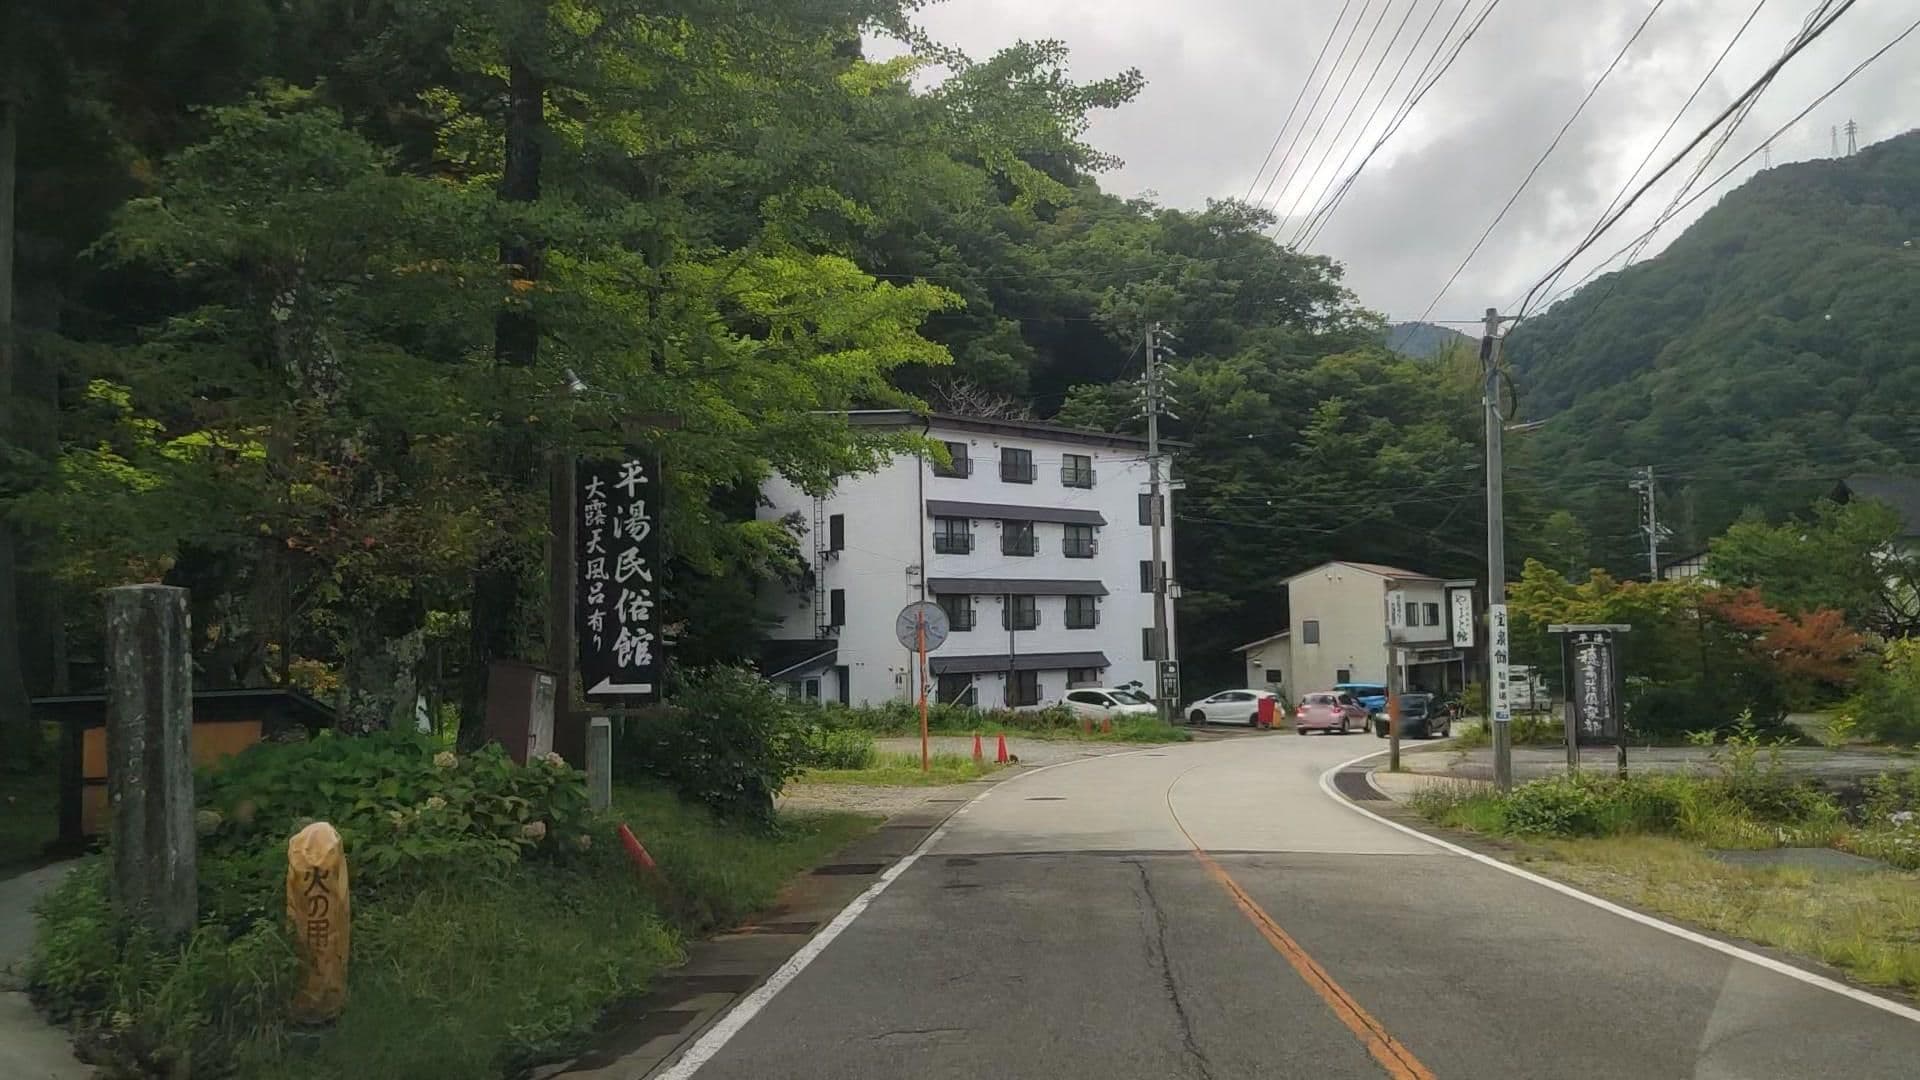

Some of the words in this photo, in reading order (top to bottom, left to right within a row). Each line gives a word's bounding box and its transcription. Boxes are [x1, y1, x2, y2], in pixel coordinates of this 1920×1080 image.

[585, 476, 609, 652] 大露天風呂有り
[613, 460, 654, 668] 平湯民俗館
